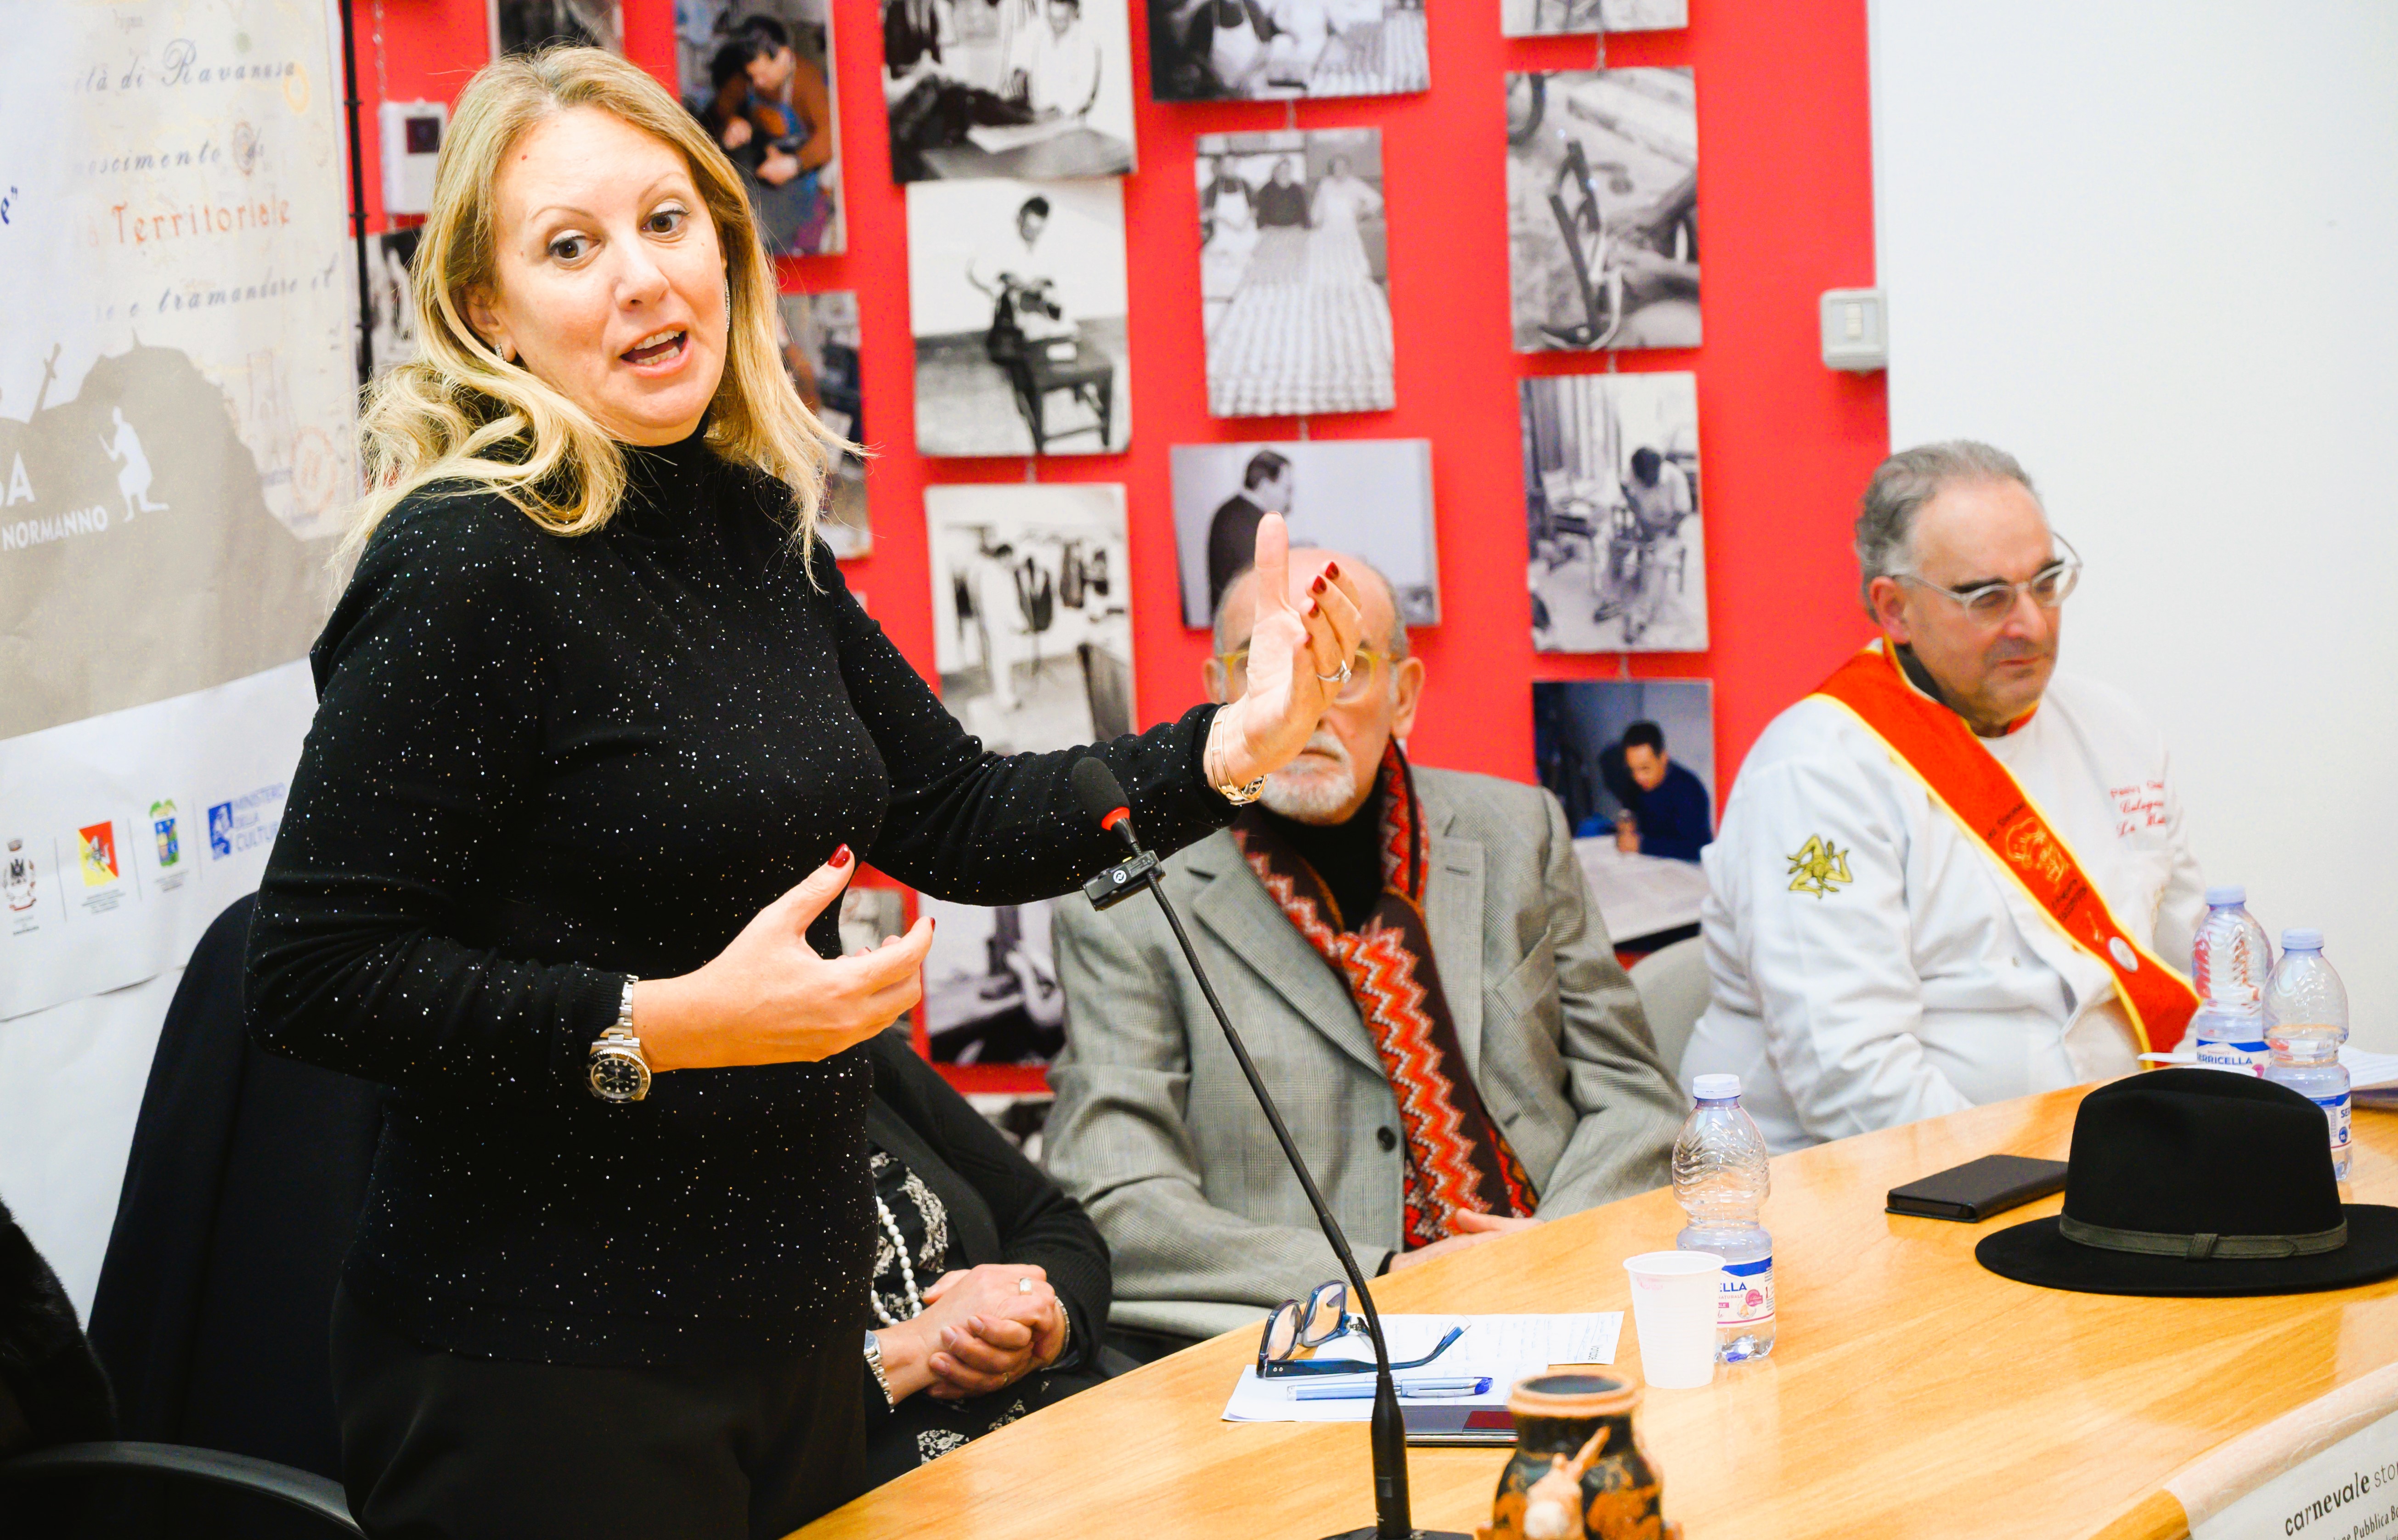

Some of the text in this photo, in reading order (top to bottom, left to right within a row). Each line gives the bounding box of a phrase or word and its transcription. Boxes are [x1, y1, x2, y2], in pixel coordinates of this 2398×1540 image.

[0, 450, 35, 507] A
[2, 505, 108, 551] NORMANNO
[2285, 1461, 2398, 1536] carnevale sto
[2353, 1514, 2389, 1540] Pubblica
